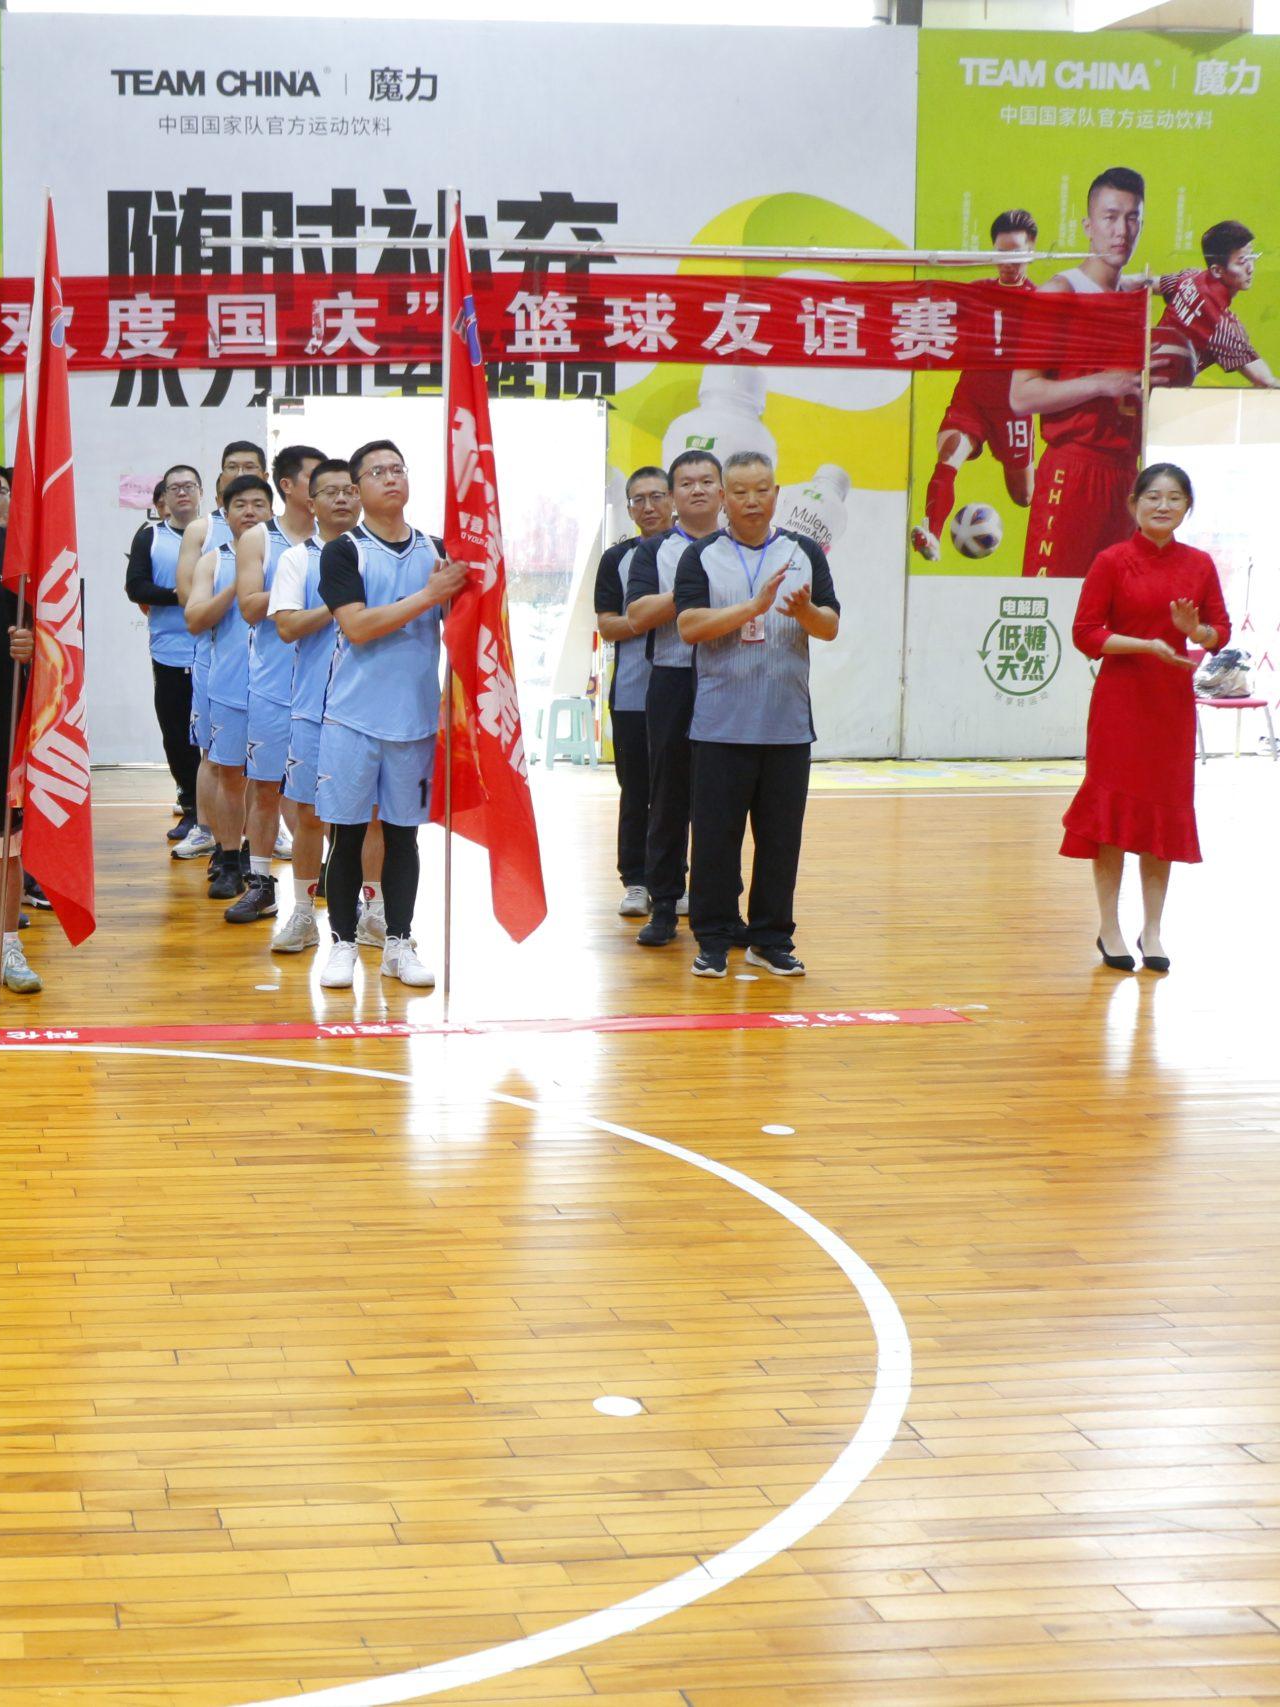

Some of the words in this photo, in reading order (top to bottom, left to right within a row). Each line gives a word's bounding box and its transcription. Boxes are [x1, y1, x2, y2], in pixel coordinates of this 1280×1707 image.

[111, 69, 205, 96] TEAM
[216, 70, 321, 97] CHINA
[369, 66, 438, 103] 魔力
[959, 57, 1045, 89] TEAM
[1055, 60, 1150, 91] CHINA
[1193, 58, 1262, 97] 魔力
[158, 115, 392, 136] 中国国家队官方运动饮料
[1000, 104, 1214, 129] 中国国家队官方运动饮料
[1006, 420, 1028, 448] 19
[1002, 600, 1047, 616] 电解质
[999, 624, 1047, 651] 低糖
[996, 655, 1045, 681] 天然
